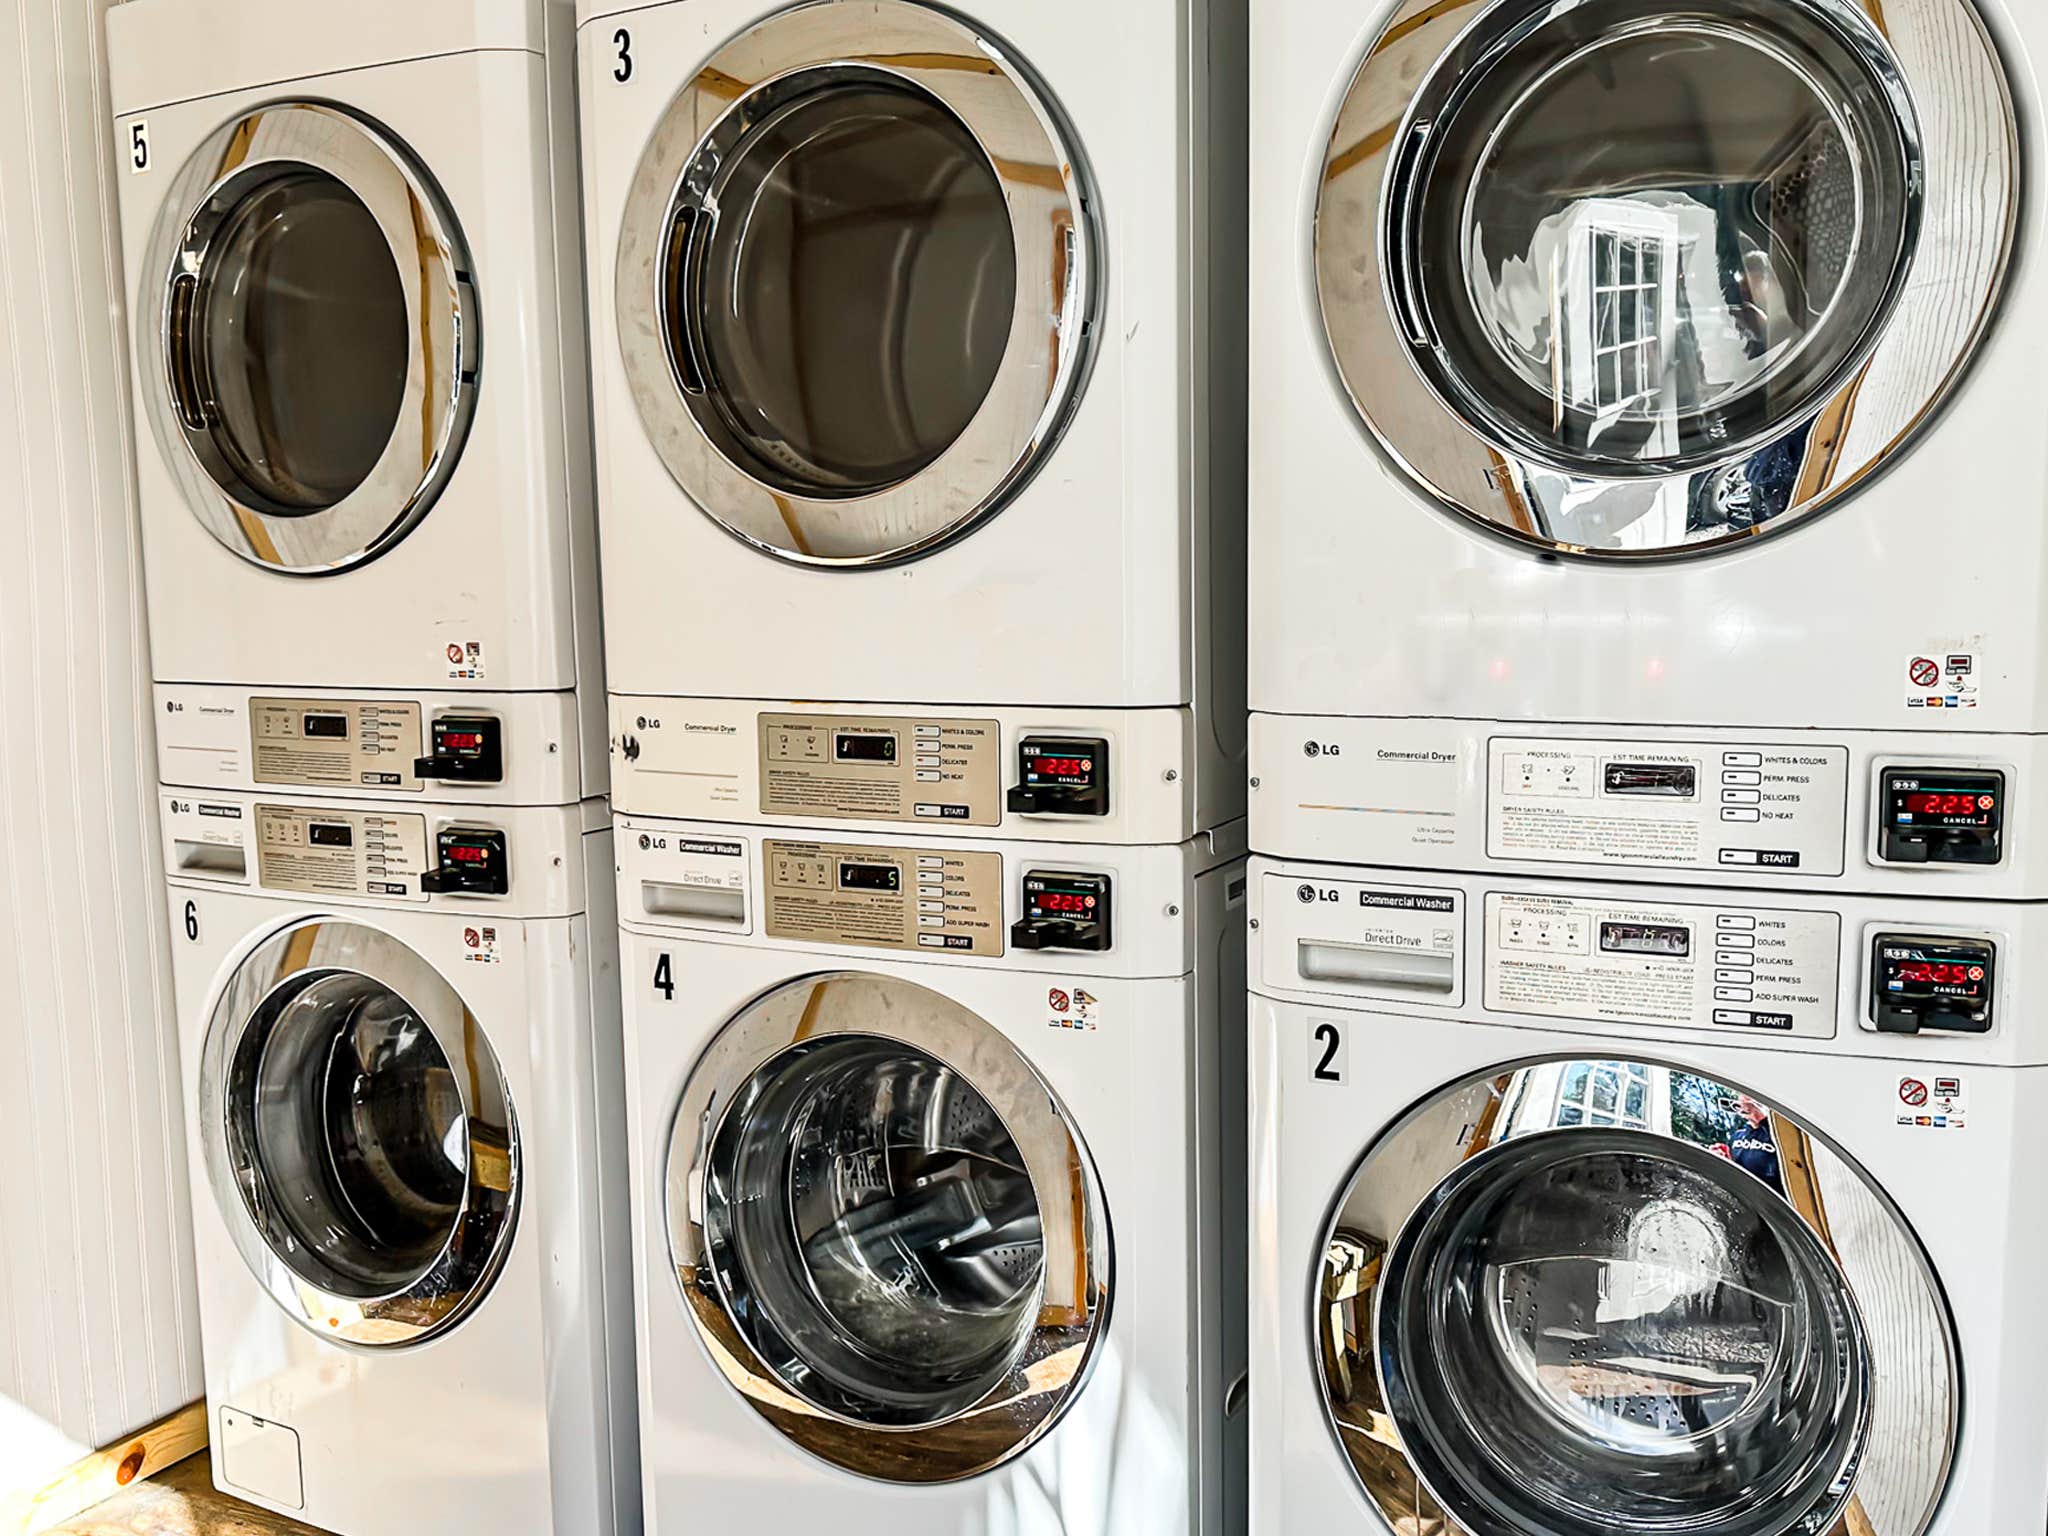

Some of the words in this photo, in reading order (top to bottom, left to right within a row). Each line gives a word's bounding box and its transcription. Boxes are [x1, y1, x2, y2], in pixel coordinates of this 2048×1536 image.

[613, 28, 632, 82] 3
[133, 124, 147, 169] 5
[175, 703, 183, 711] LG
[648, 719, 660, 729] LG
[1322, 744, 1340, 756] LG
[1527, 751, 1572, 759] PROCESSING
[1377, 750, 1429, 760] Commercial
[1431, 752, 1456, 763] Dryer
[1764, 756, 1791, 765] WHITES
[1799, 757, 1828, 765] COLORS
[1786, 776, 1810, 784] PRESS
[1763, 794, 1801, 802] DELICATES
[180, 803, 190, 813] LG
[943, 807, 965, 816] START
[1762, 812, 1773, 820] NO
[1775, 812, 1794, 820] HEAT
[1943, 817, 1976, 825] CANCEL
[652, 838, 666, 849] LG
[680, 841, 716, 852] Commercial
[717, 846, 740, 854] Washer
[1761, 853, 1794, 864] START
[1319, 889, 1339, 902] LG
[1362, 893, 1415, 908] Commercial
[1415, 897, 1452, 910] Washer
[185, 899, 198, 941] 6
[1759, 920, 1786, 929] WHITES
[947, 937, 969, 946] START
[1365, 932, 1395, 945] Direct
[1395, 935, 1422, 947] Drive
[1757, 938, 1786, 947] COLORS
[1756, 957, 1793, 966] DELICATES
[654, 953, 674, 1000] 4
[1778, 976, 1801, 984] PRESS
[1933, 986, 1967, 995] CANCEL
[1772, 994, 1797, 1002] SUPER
[1797, 995, 1819, 1004] WASH
[1755, 1015, 1787, 1026] START
[1314, 1023, 1340, 1081] 2
